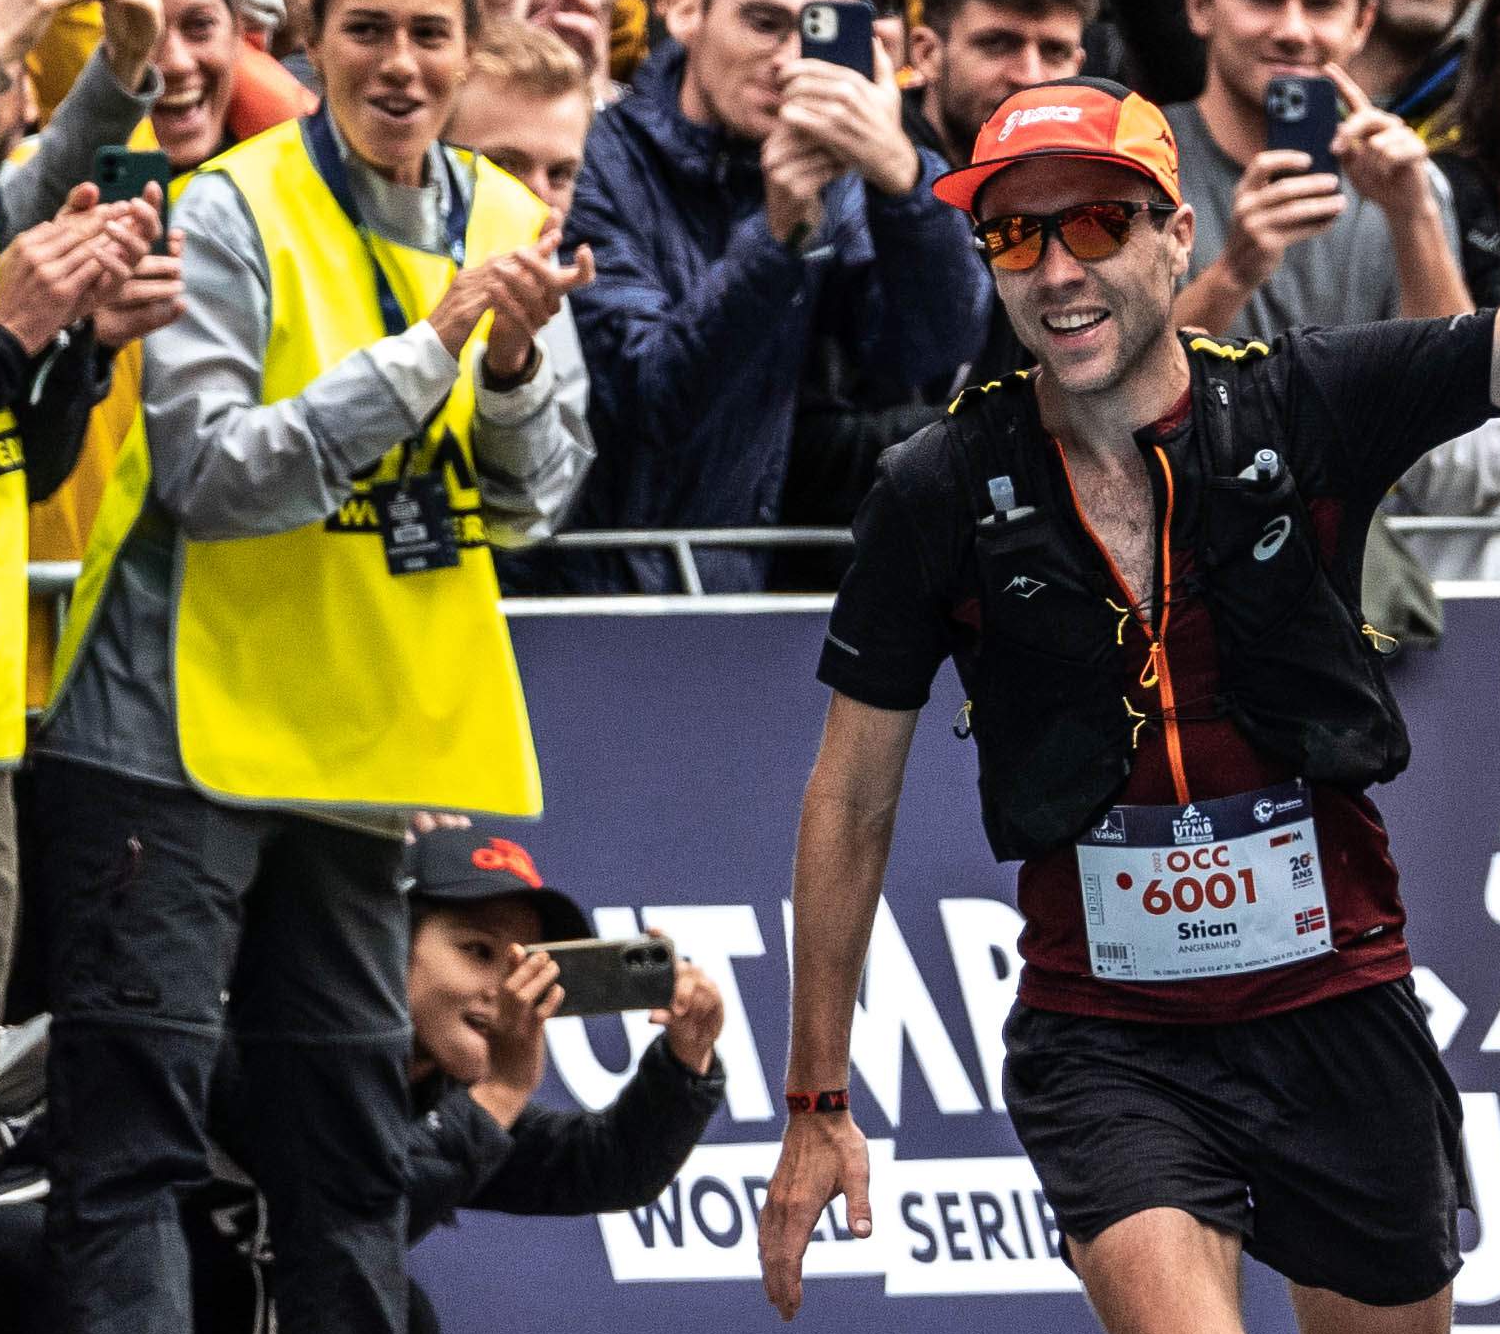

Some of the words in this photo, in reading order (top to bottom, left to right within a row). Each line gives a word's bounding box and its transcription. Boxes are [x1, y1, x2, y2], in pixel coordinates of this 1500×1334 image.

[1094, 830, 1123, 840] Valais
[1173, 823, 1213, 837] UTMB
[1166, 845, 1231, 873] OCC
[1142, 868, 1258, 916] 6001
[1177, 918, 1238, 940] Stian
[1177, 939, 1242, 955] ANGERMUND
[901, 1189, 1061, 1263] SERIE
